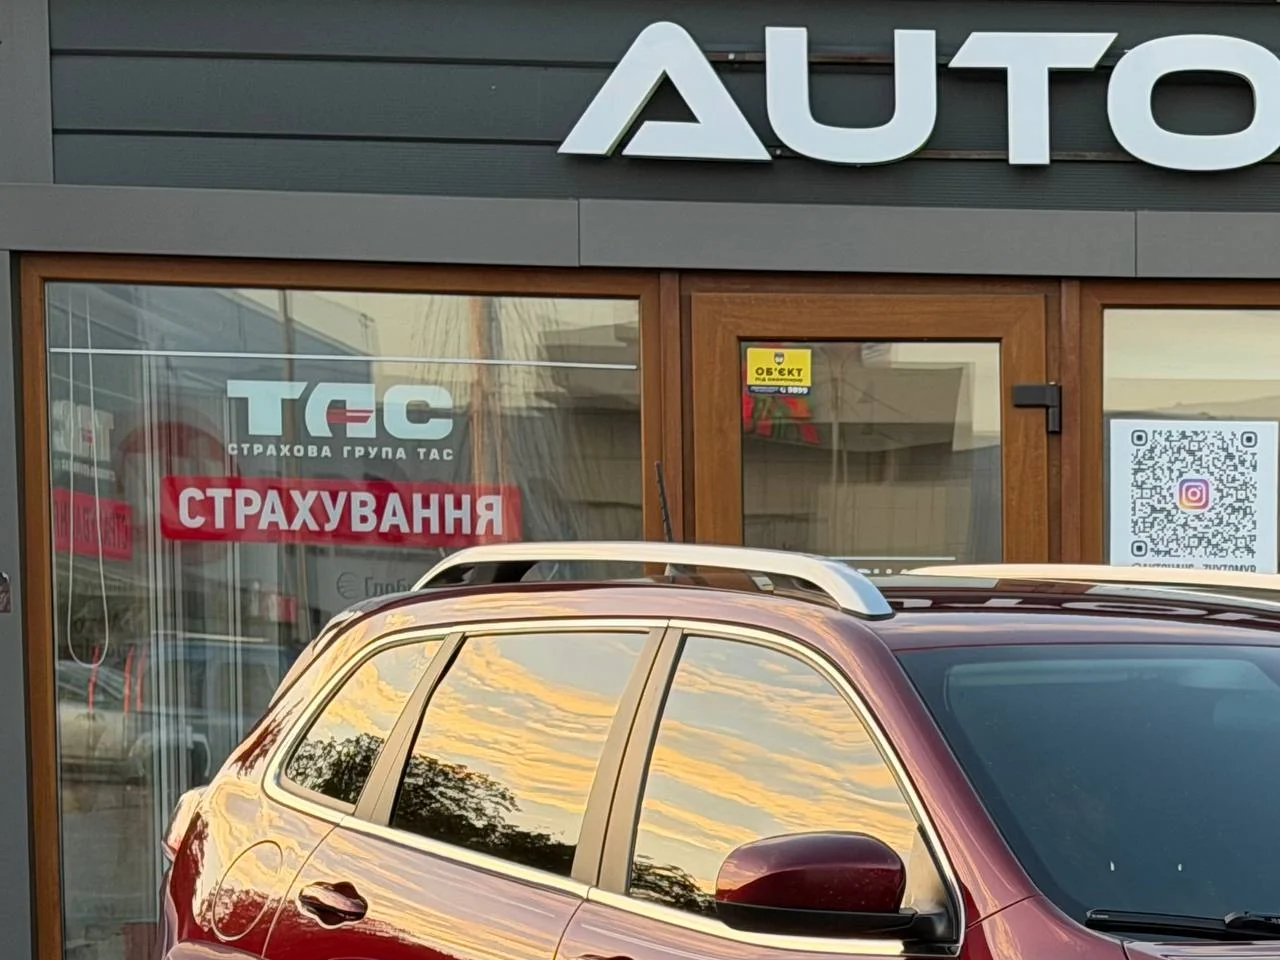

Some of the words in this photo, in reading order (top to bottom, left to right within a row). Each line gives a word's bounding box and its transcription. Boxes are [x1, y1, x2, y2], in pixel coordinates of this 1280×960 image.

[227, 379, 454, 440] ТАС
[227, 443, 332, 458] СТРАХОВА
[343, 446, 406, 460] ГРУПА
[417, 447, 454, 461] ТАС
[178, 487, 503, 536] СТРАХУВАННЯ
